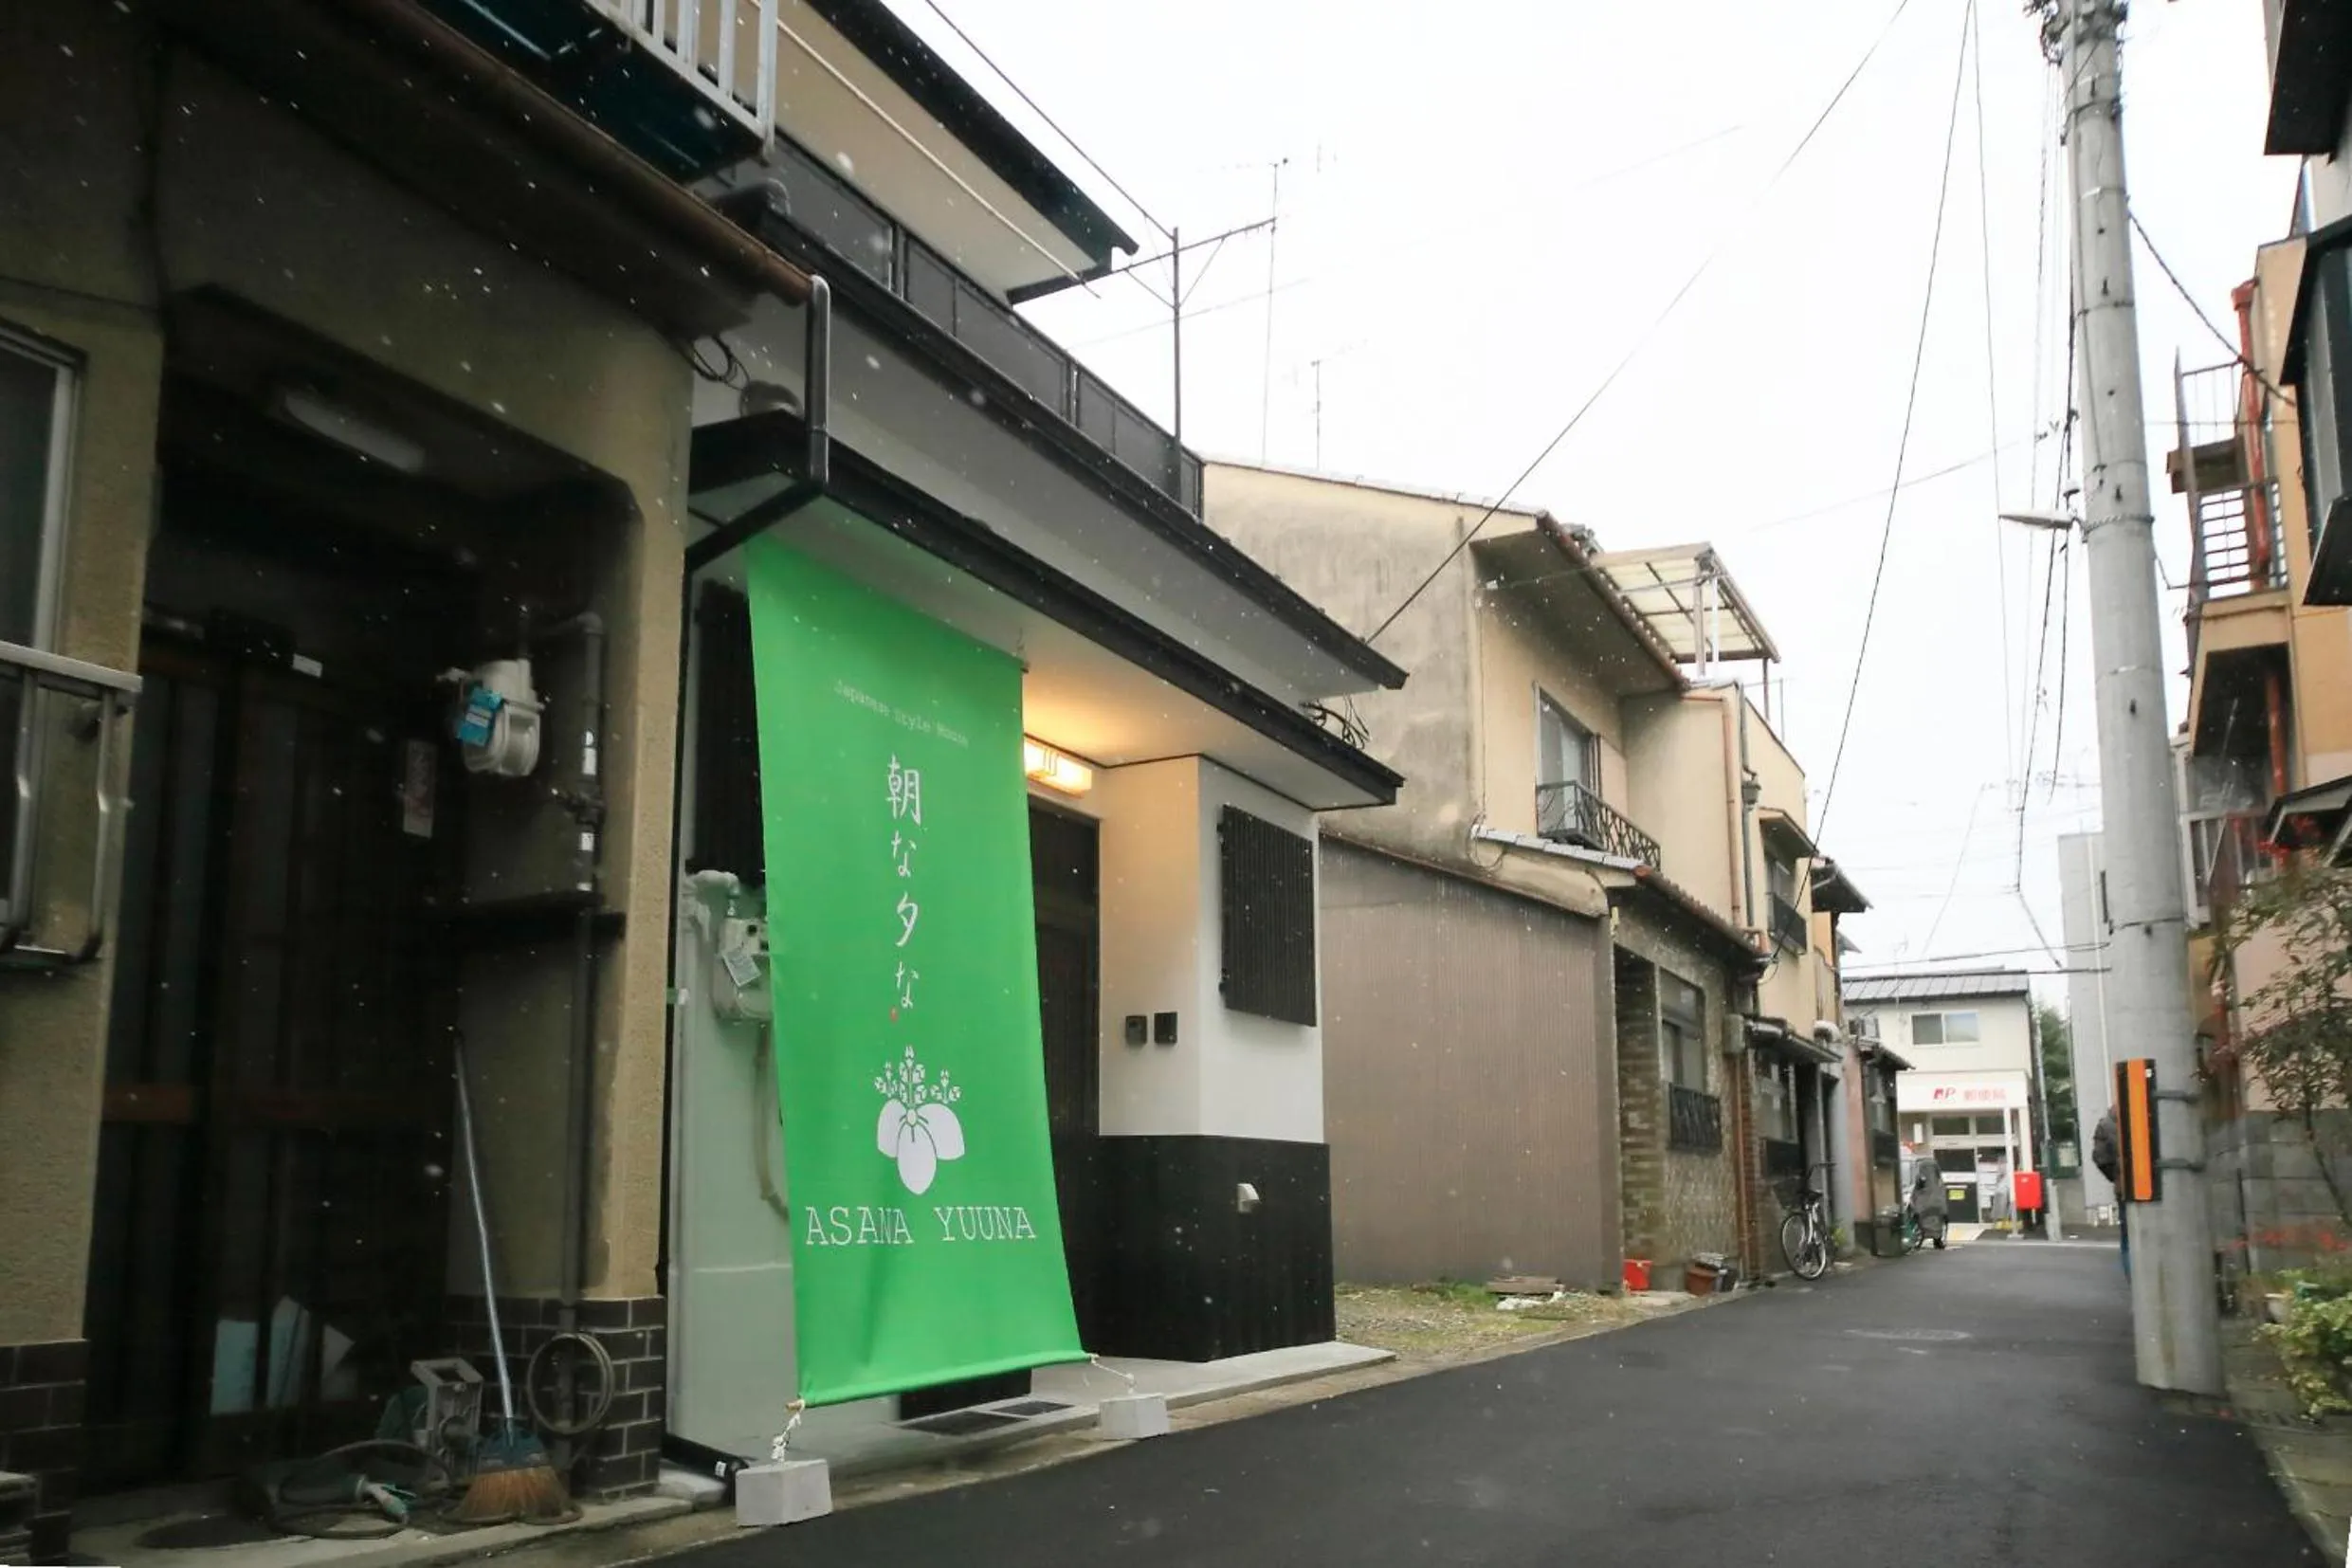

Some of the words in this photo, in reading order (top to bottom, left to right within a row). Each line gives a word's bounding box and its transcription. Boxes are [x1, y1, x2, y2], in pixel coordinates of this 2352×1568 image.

[885, 752, 921, 1009] 朝な夕な
[805, 1205, 914, 1247] ASANA
[933, 1206, 1037, 1242] YUUNA
